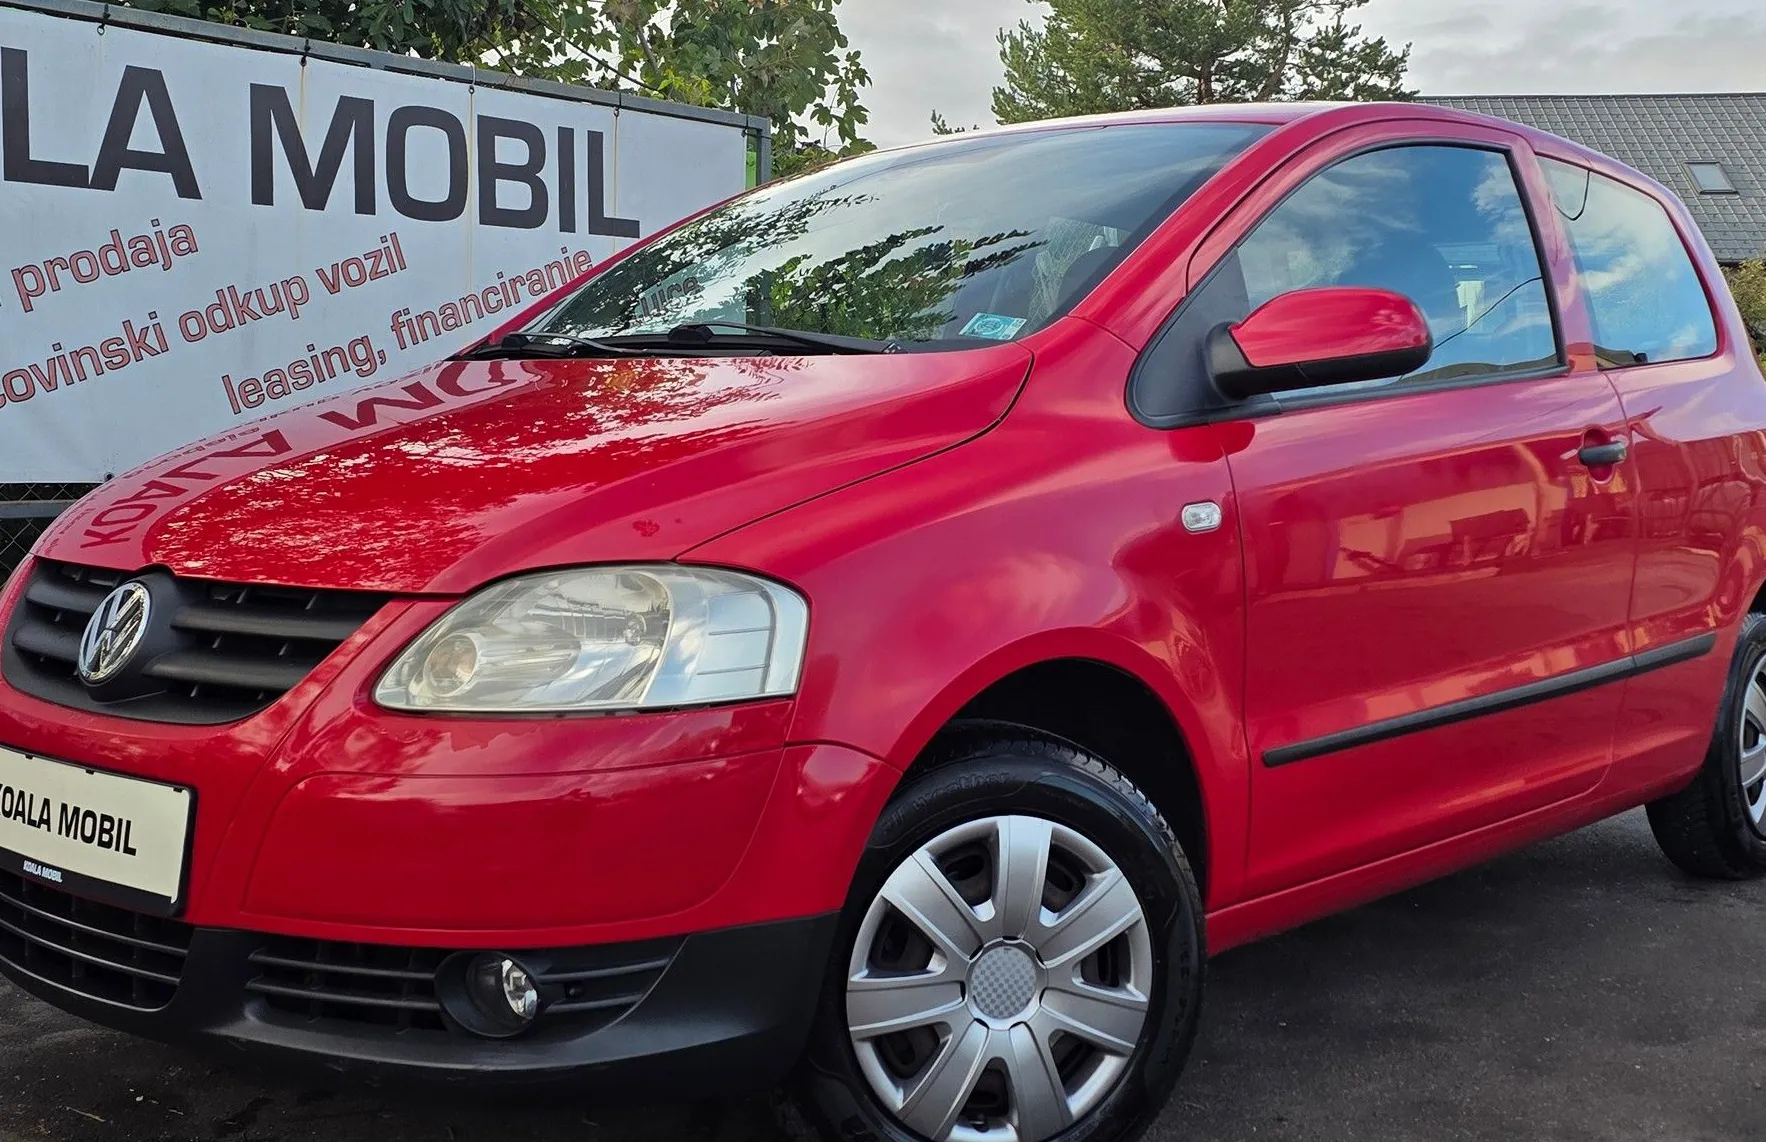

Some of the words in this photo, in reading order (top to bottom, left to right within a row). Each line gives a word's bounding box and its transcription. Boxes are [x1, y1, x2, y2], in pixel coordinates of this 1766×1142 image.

[250, 83, 641, 238] MOBIL
[11, 219, 199, 312] prodaja
[180, 274, 310, 344] odkup
[316, 232, 407, 294] vozil
[222, 336, 387, 414] leasing,
[23, 860, 42, 876] KOALA
[41, 867, 63, 883] MOBIL
[58, 802, 137, 856] MOBIL
